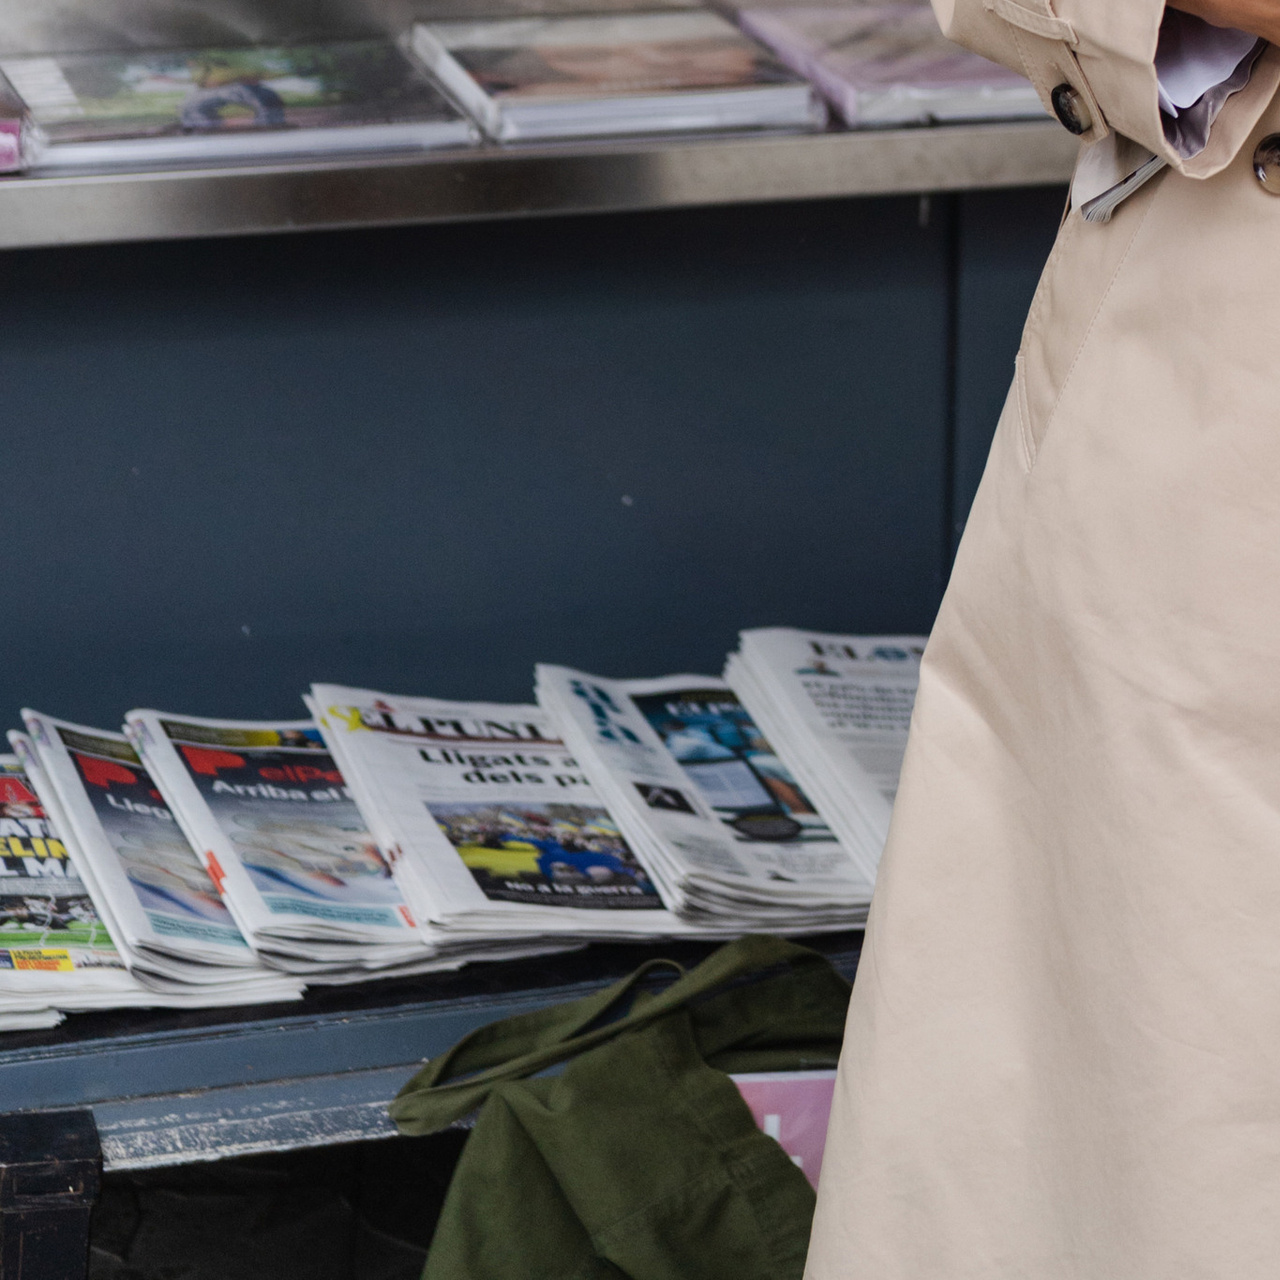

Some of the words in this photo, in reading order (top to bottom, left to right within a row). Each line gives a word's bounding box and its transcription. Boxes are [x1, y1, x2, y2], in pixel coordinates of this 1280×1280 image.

[417, 747, 551, 769] Lligats
[462, 769, 546, 785] dels
[211, 778, 309, 801] Arriba
[310, 787, 342, 802] el
